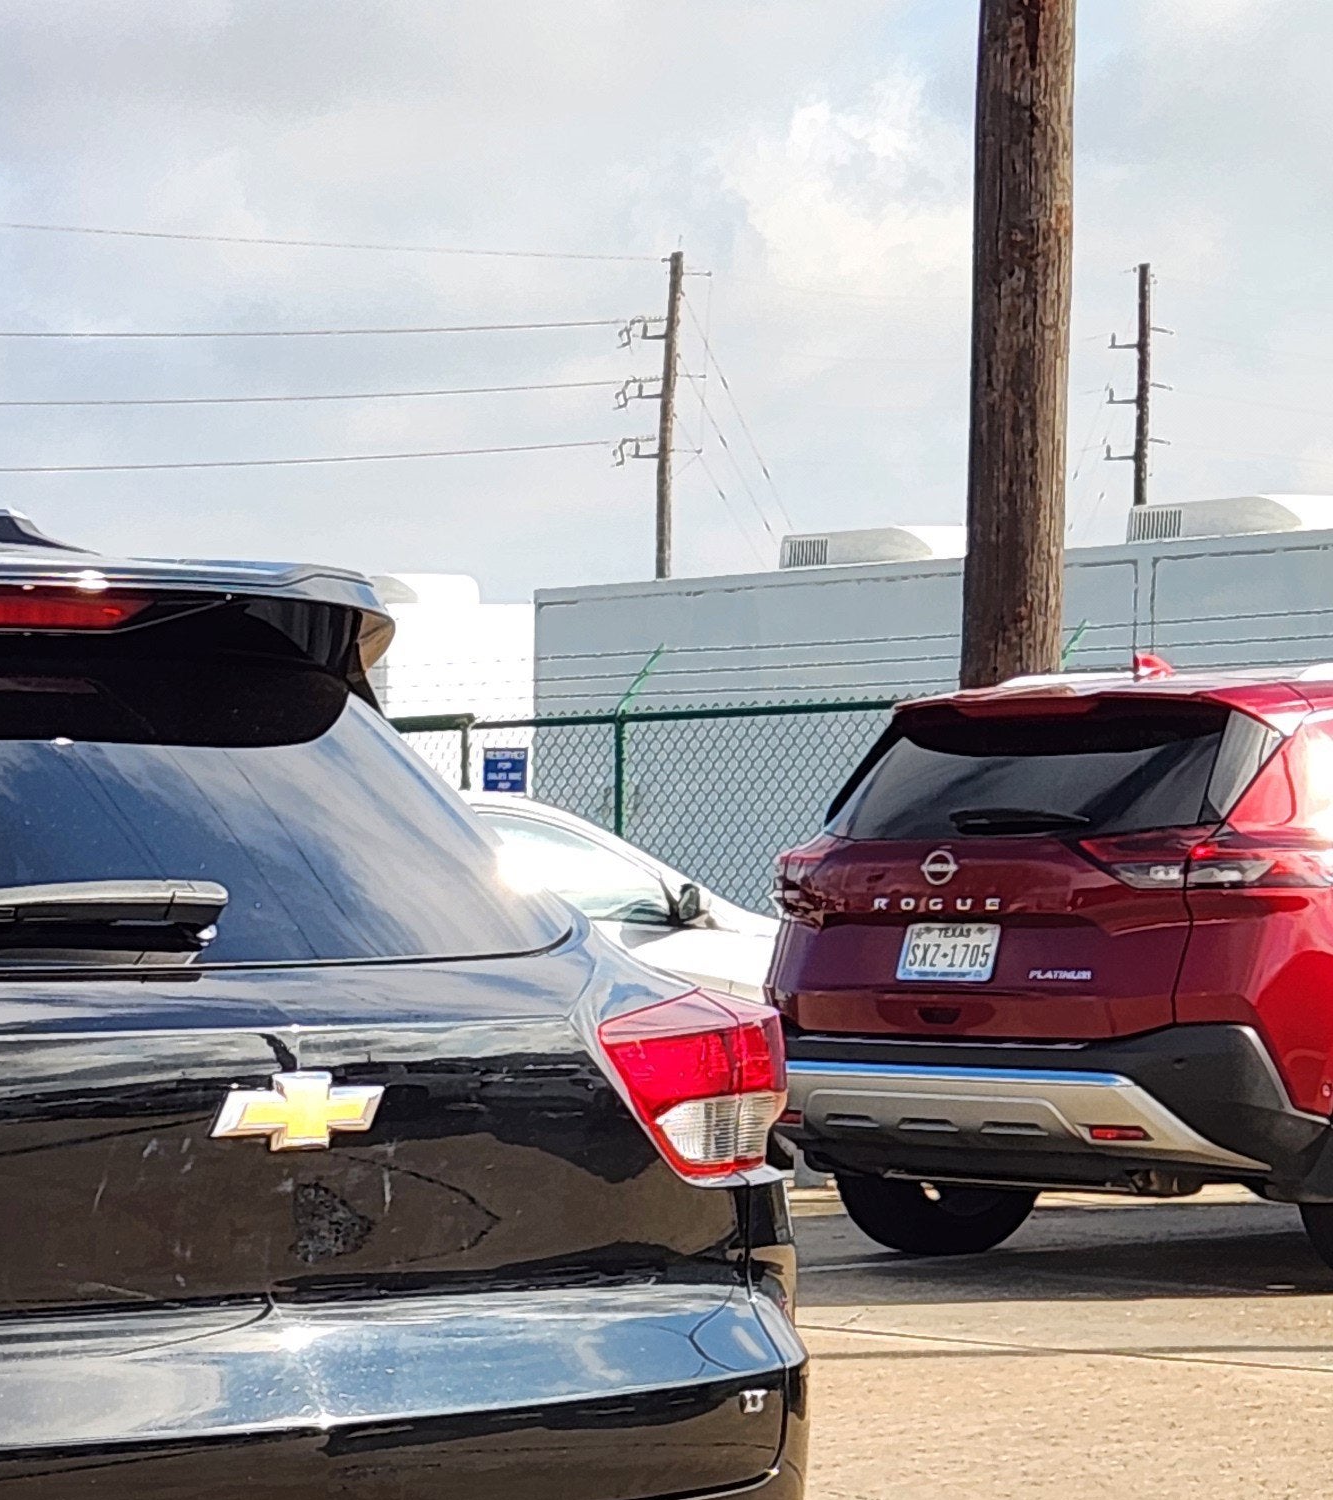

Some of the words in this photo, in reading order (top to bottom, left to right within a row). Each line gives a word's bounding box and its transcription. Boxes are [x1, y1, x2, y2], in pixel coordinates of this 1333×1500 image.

[873, 897, 1001, 911] ROGUE
[937, 927, 972, 939] TEXAS
[1028, 970, 1093, 981] PLATINUM
